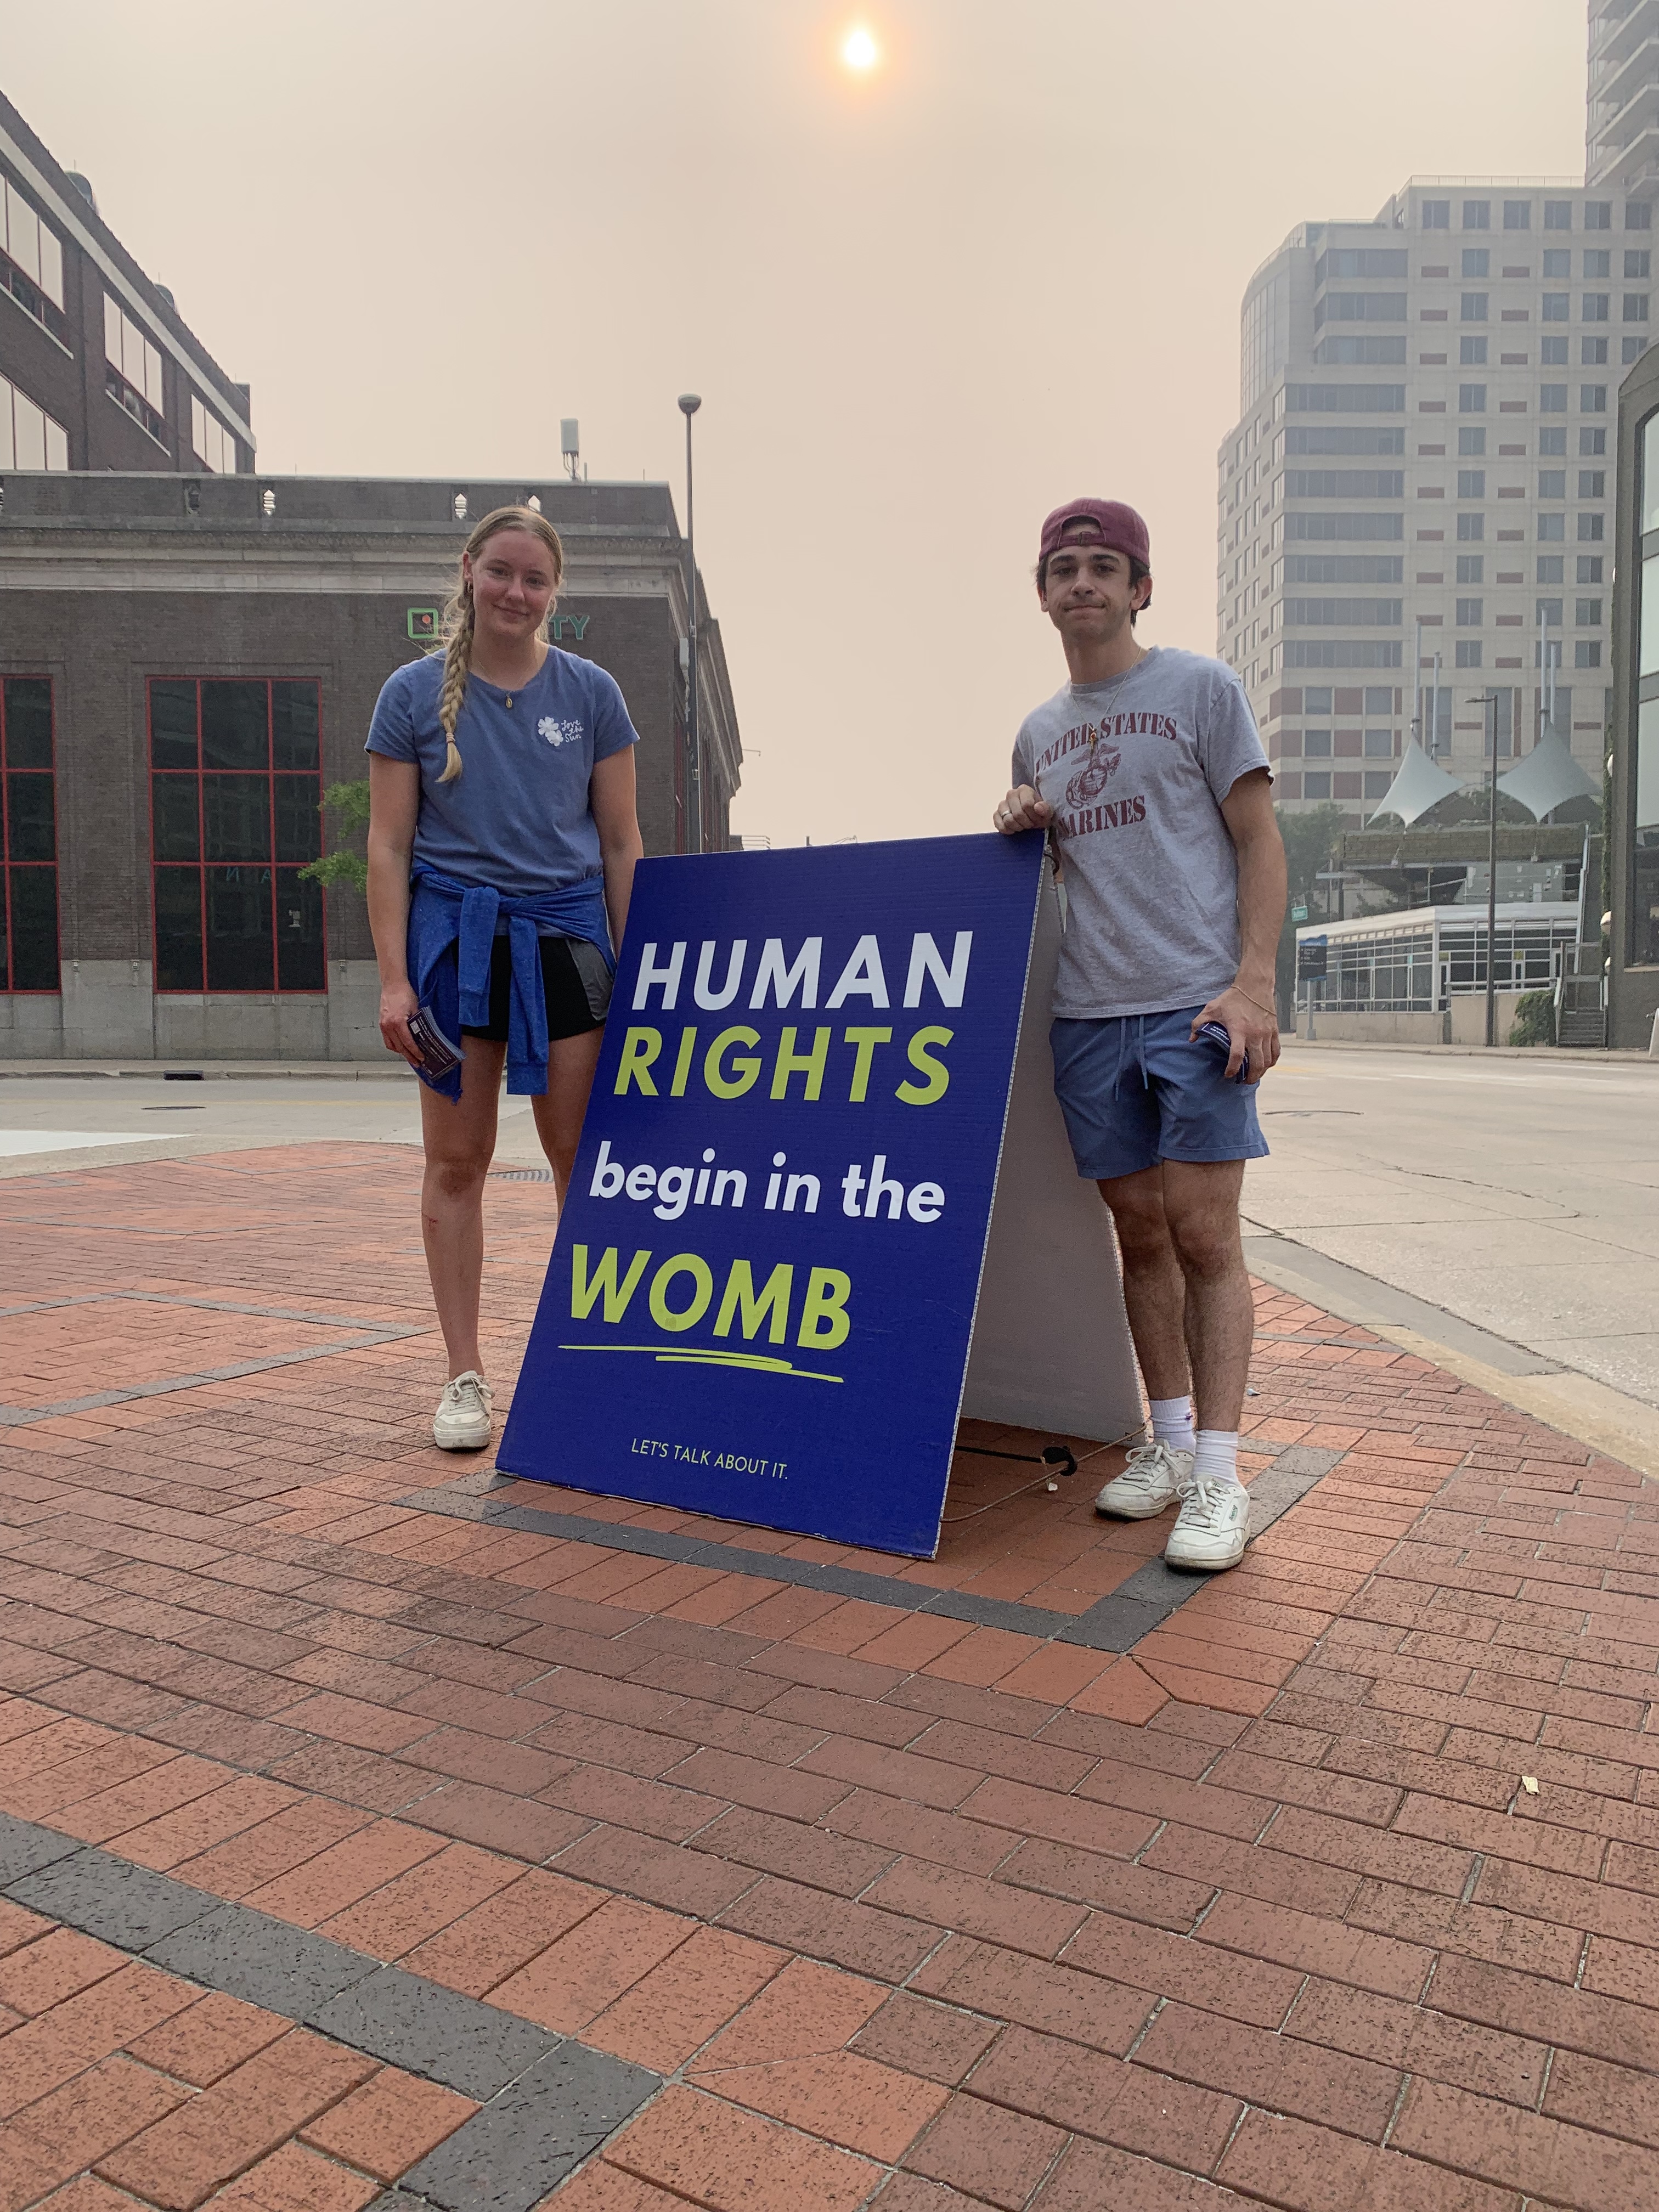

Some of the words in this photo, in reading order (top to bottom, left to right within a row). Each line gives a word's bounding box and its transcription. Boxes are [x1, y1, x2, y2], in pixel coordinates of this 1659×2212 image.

[561, 719, 581, 732] Love
[565, 733, 582, 743] Sun
[568, 725, 584, 735] the
[1035, 722, 1097, 774] UNITED
[1100, 712, 1177, 741] STATES
[632, 931, 973, 1010] HUMAN
[613, 1025, 955, 1105] RIGHTS
[589, 1141, 747, 1221] begin
[764, 1152, 821, 1213] in
[841, 1154, 945, 1223] the
[571, 1244, 851, 1350] WOMB
[631, 1438, 669, 1458] LET'S
[674, 1445, 712, 1465] TALK
[713, 1453, 769, 1475] ABOUT
[772, 1462, 788, 1480] IT.
